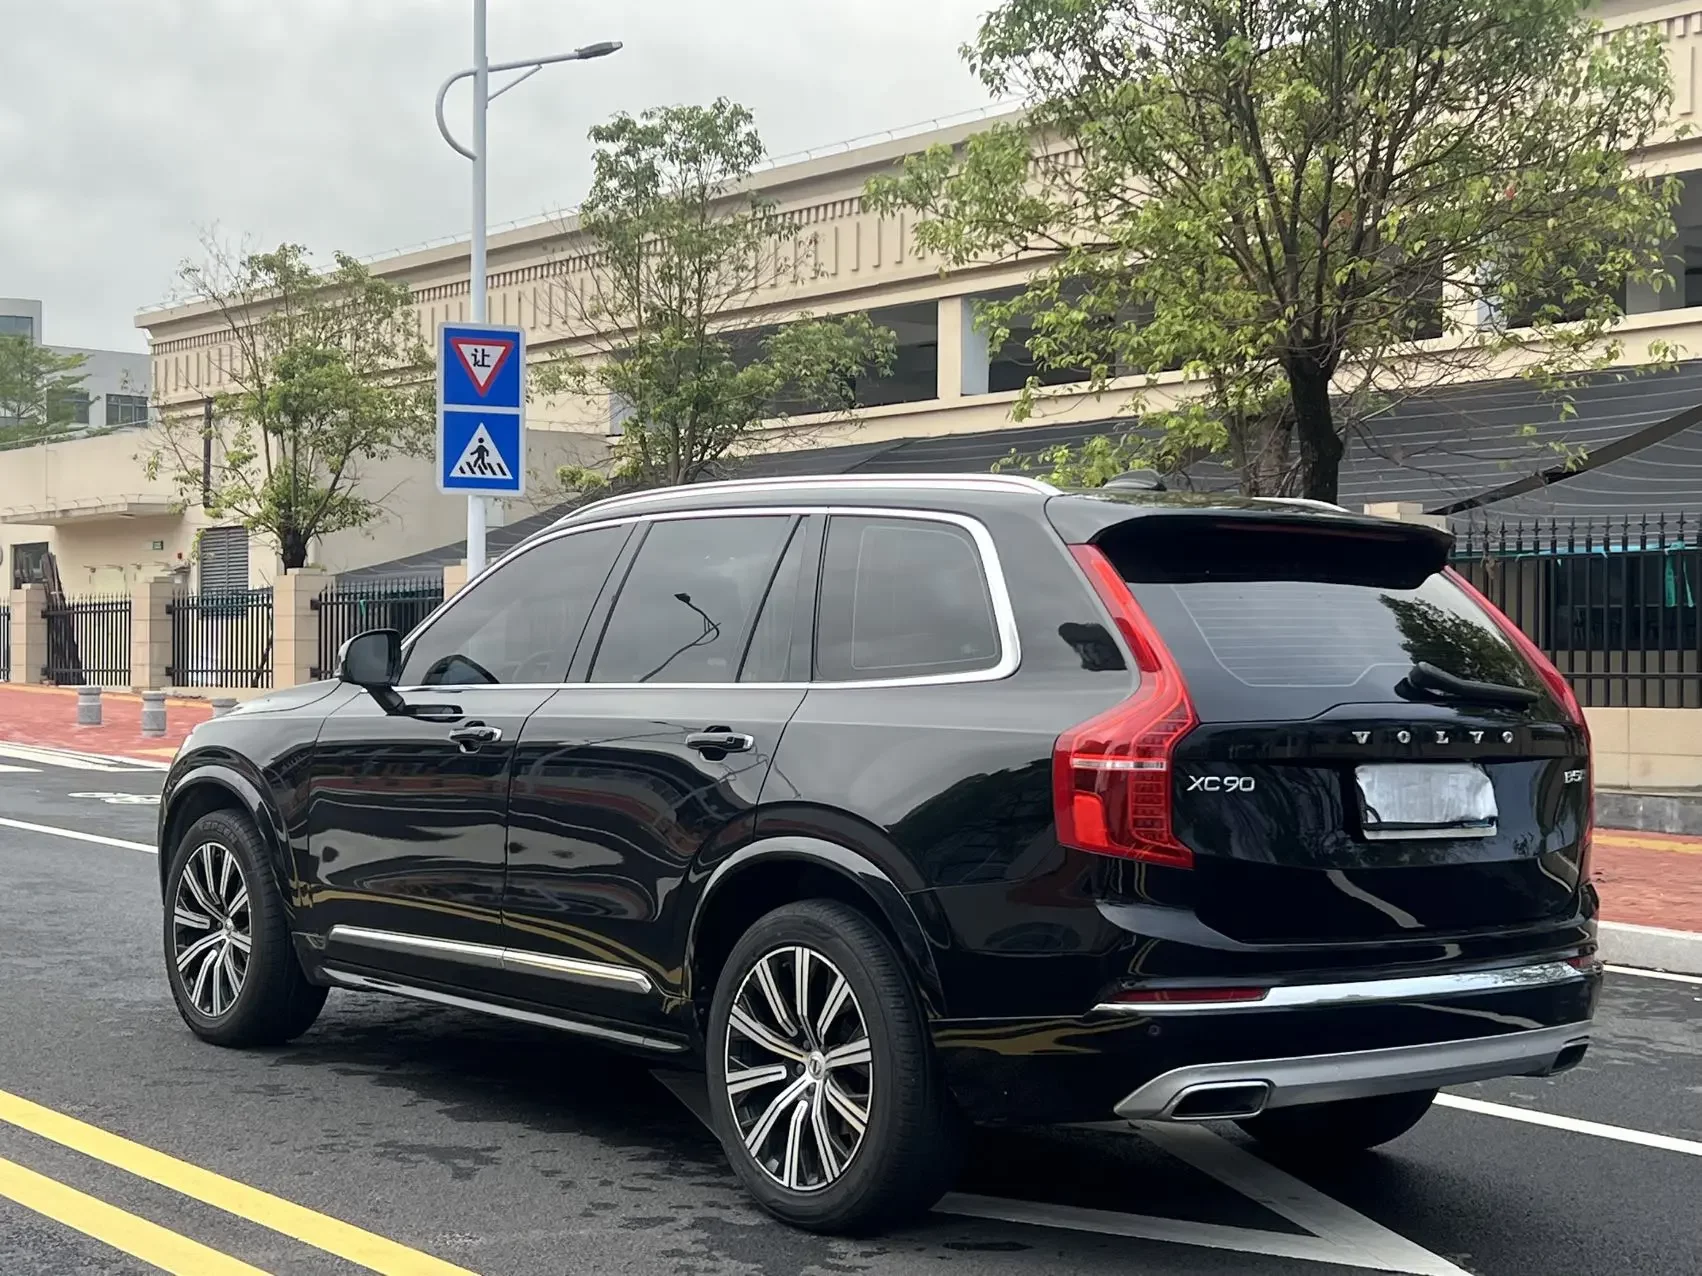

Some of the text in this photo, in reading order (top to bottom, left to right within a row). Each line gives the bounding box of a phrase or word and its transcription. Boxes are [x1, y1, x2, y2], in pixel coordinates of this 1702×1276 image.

[470, 348, 491, 368] 让
[1352, 730, 1514, 745] VOLVO
[1186, 775, 1257, 792] XC90
